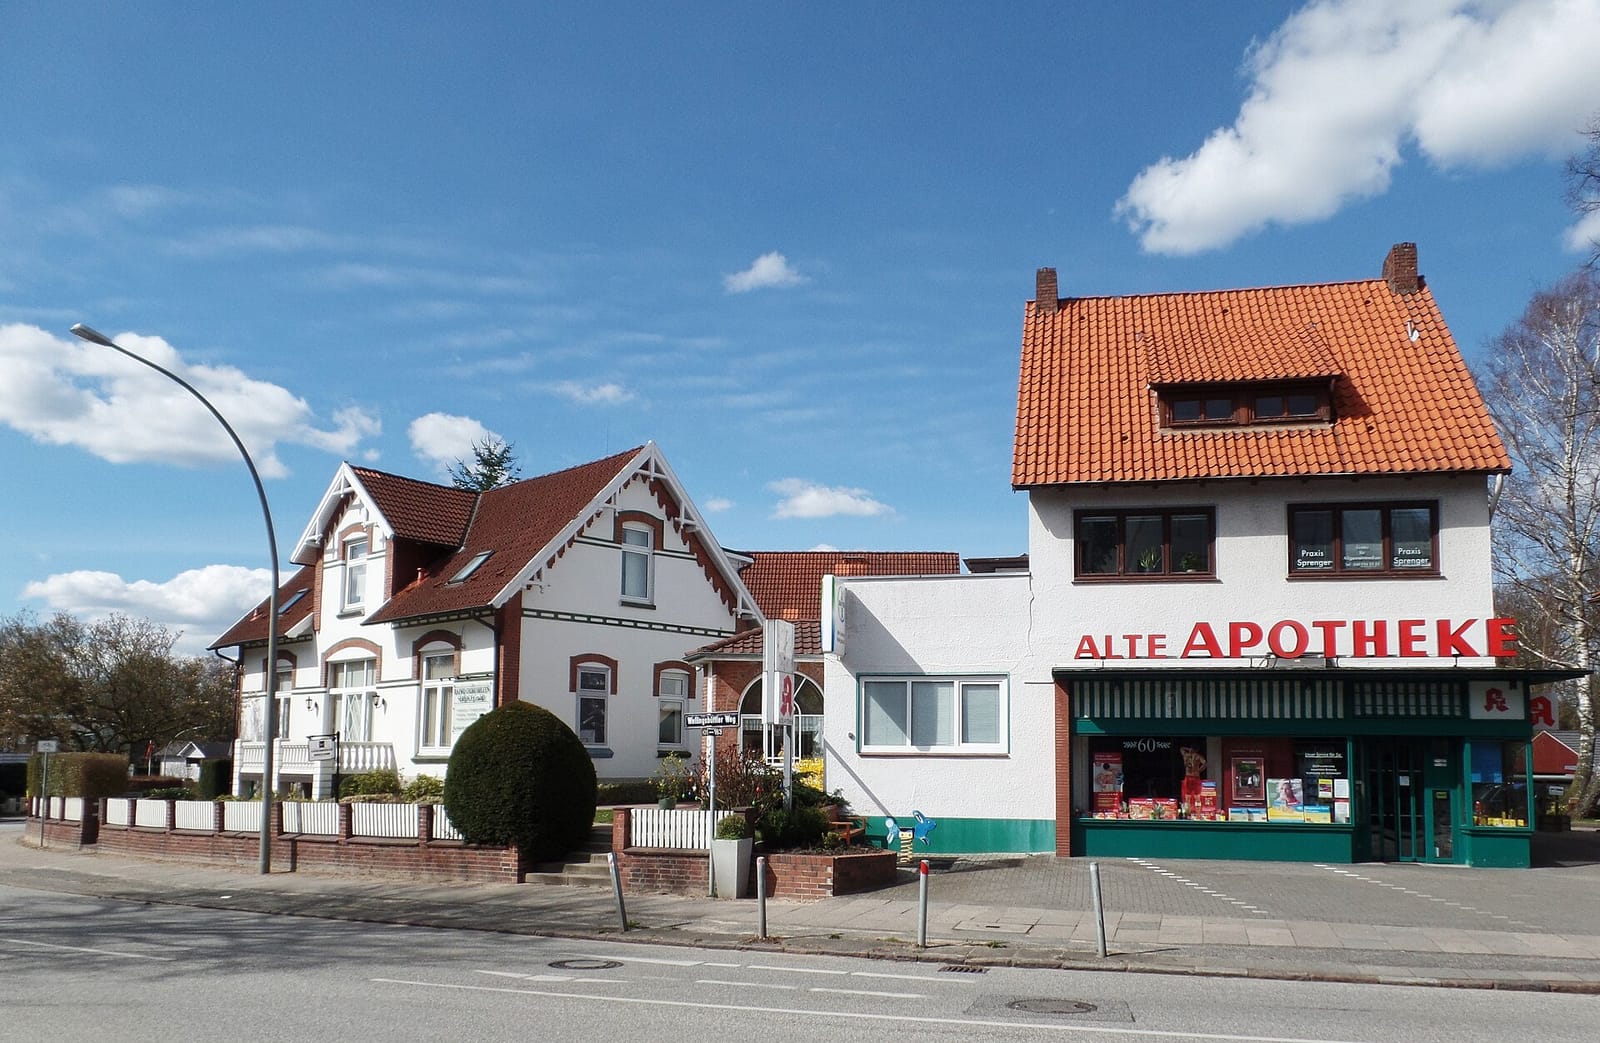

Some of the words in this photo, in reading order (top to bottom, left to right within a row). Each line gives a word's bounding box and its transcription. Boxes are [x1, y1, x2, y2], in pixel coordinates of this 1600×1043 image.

[1301, 549, 1324, 557] Praxis
[1398, 547, 1422, 555] Praxis
[1296, 558, 1334, 567] Sprenger
[1393, 556, 1430, 566] Sprenger
[1074, 634, 1167, 660] ALTE
[1181, 617, 1519, 659] APOTHEKE
[725, 714, 737, 725] Weg
[1137, 738, 1156, 753] 60
